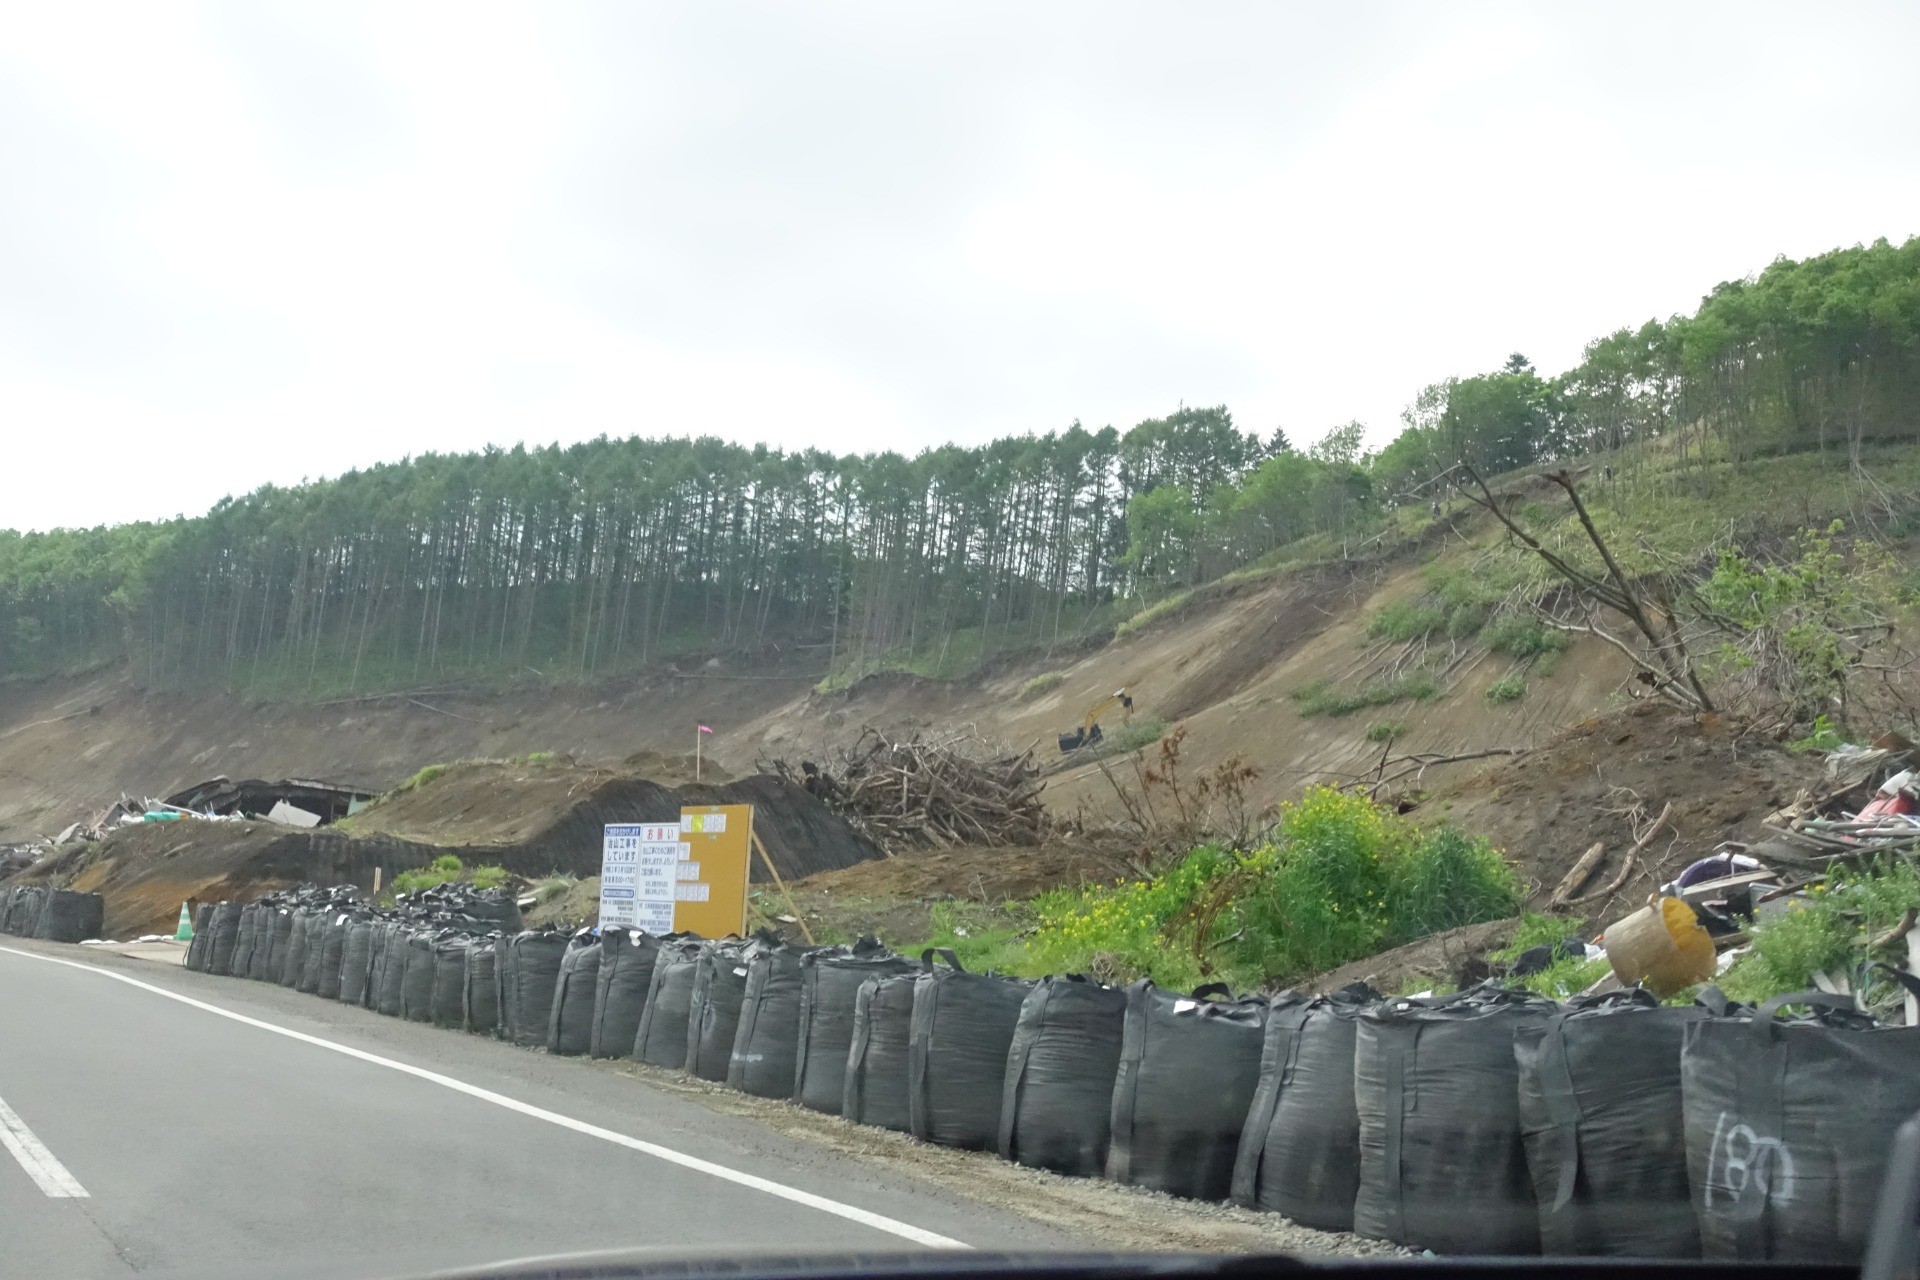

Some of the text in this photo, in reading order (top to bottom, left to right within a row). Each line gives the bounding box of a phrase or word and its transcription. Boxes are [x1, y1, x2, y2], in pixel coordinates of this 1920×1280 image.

[647, 828, 674, 840] お願い
[608, 838, 637, 849] 治山工事を
[607, 851, 635, 861] しています
[1704, 1111, 1795, 1209] 180
